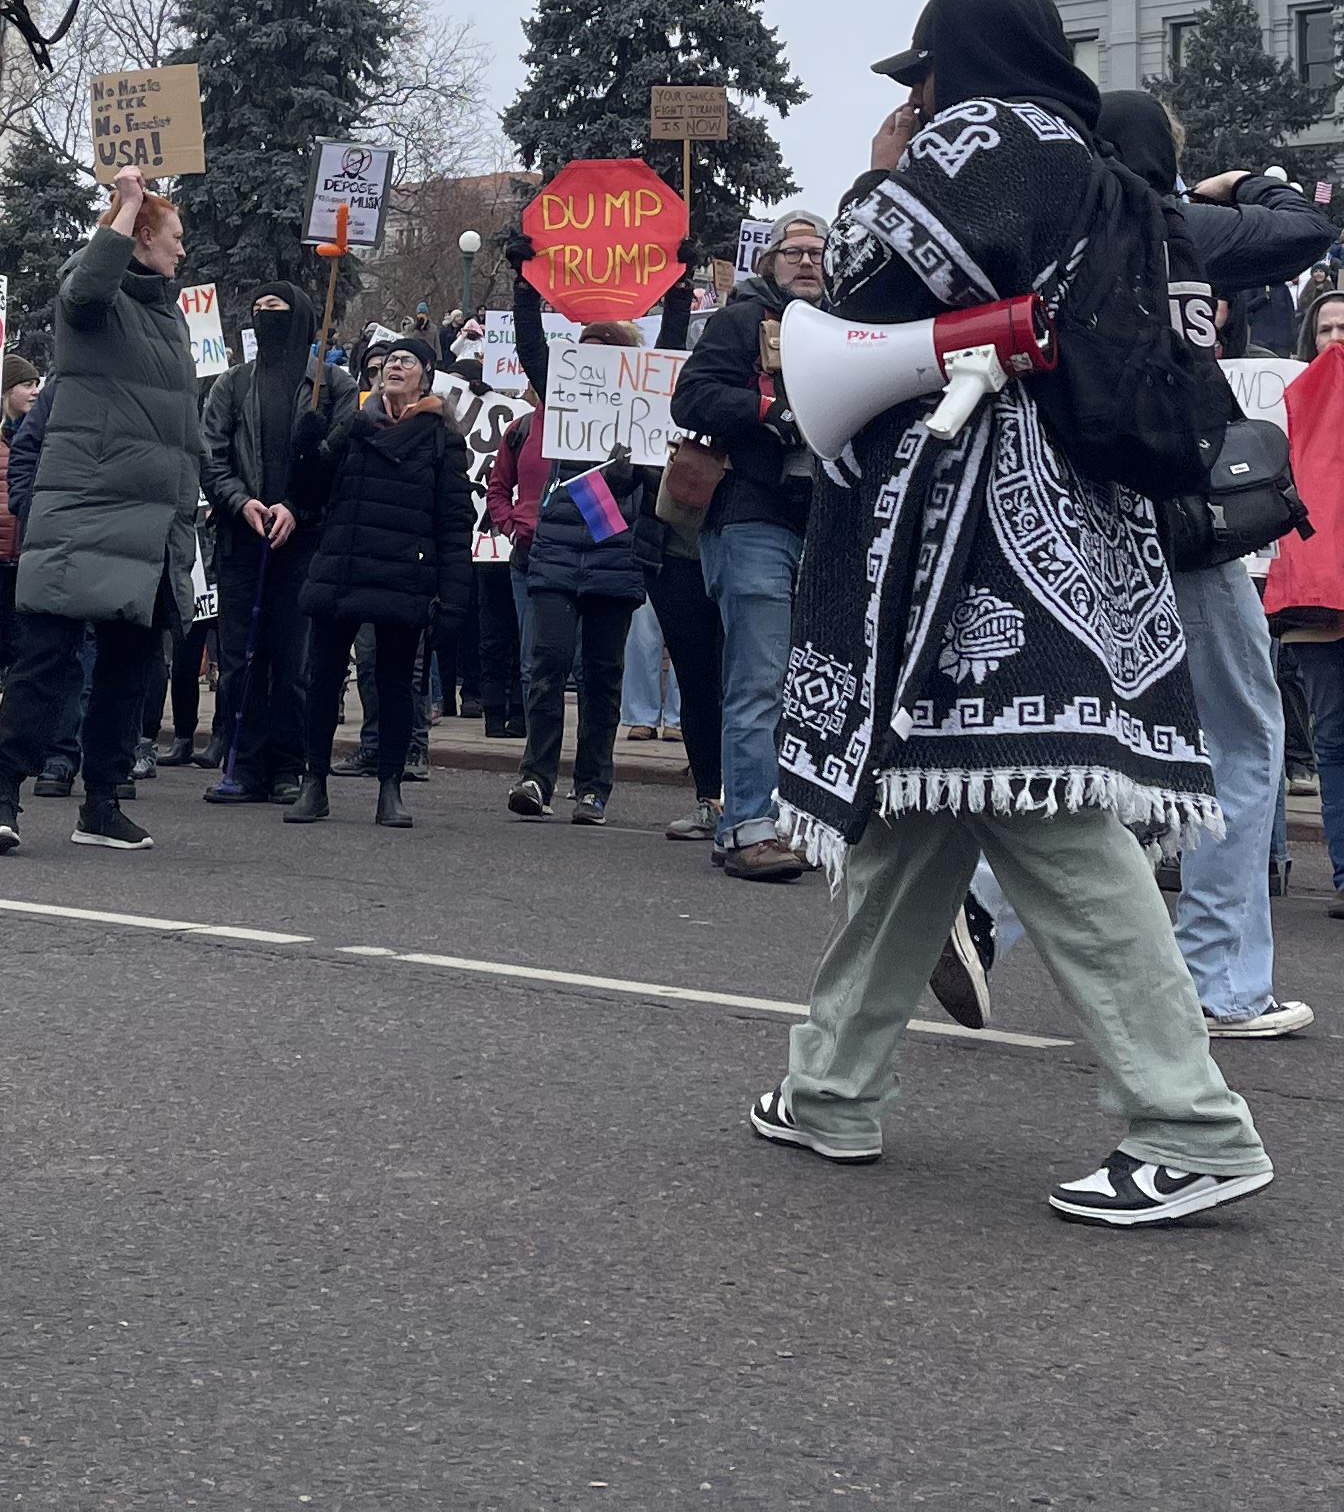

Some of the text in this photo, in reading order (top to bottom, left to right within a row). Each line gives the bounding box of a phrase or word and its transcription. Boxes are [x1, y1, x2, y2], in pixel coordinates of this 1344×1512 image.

[93, 81, 114, 101] No
[655, 90, 682, 103] YOUR
[117, 96, 147, 110] KKK
[654, 105, 684, 116] FIGHT
[95, 116, 121, 137] No
[662, 118, 721, 134] IS NOW
[98, 132, 163, 167] USA!
[324, 179, 378, 195] DEPOSE
[542, 189, 663, 230] DUMP
[536, 243, 667, 289] TRUMP
[182, 287, 215, 314] HY
[556, 349, 606, 385] Say
[552, 383, 623, 406] to the
[548, 406, 620, 452] Turd
